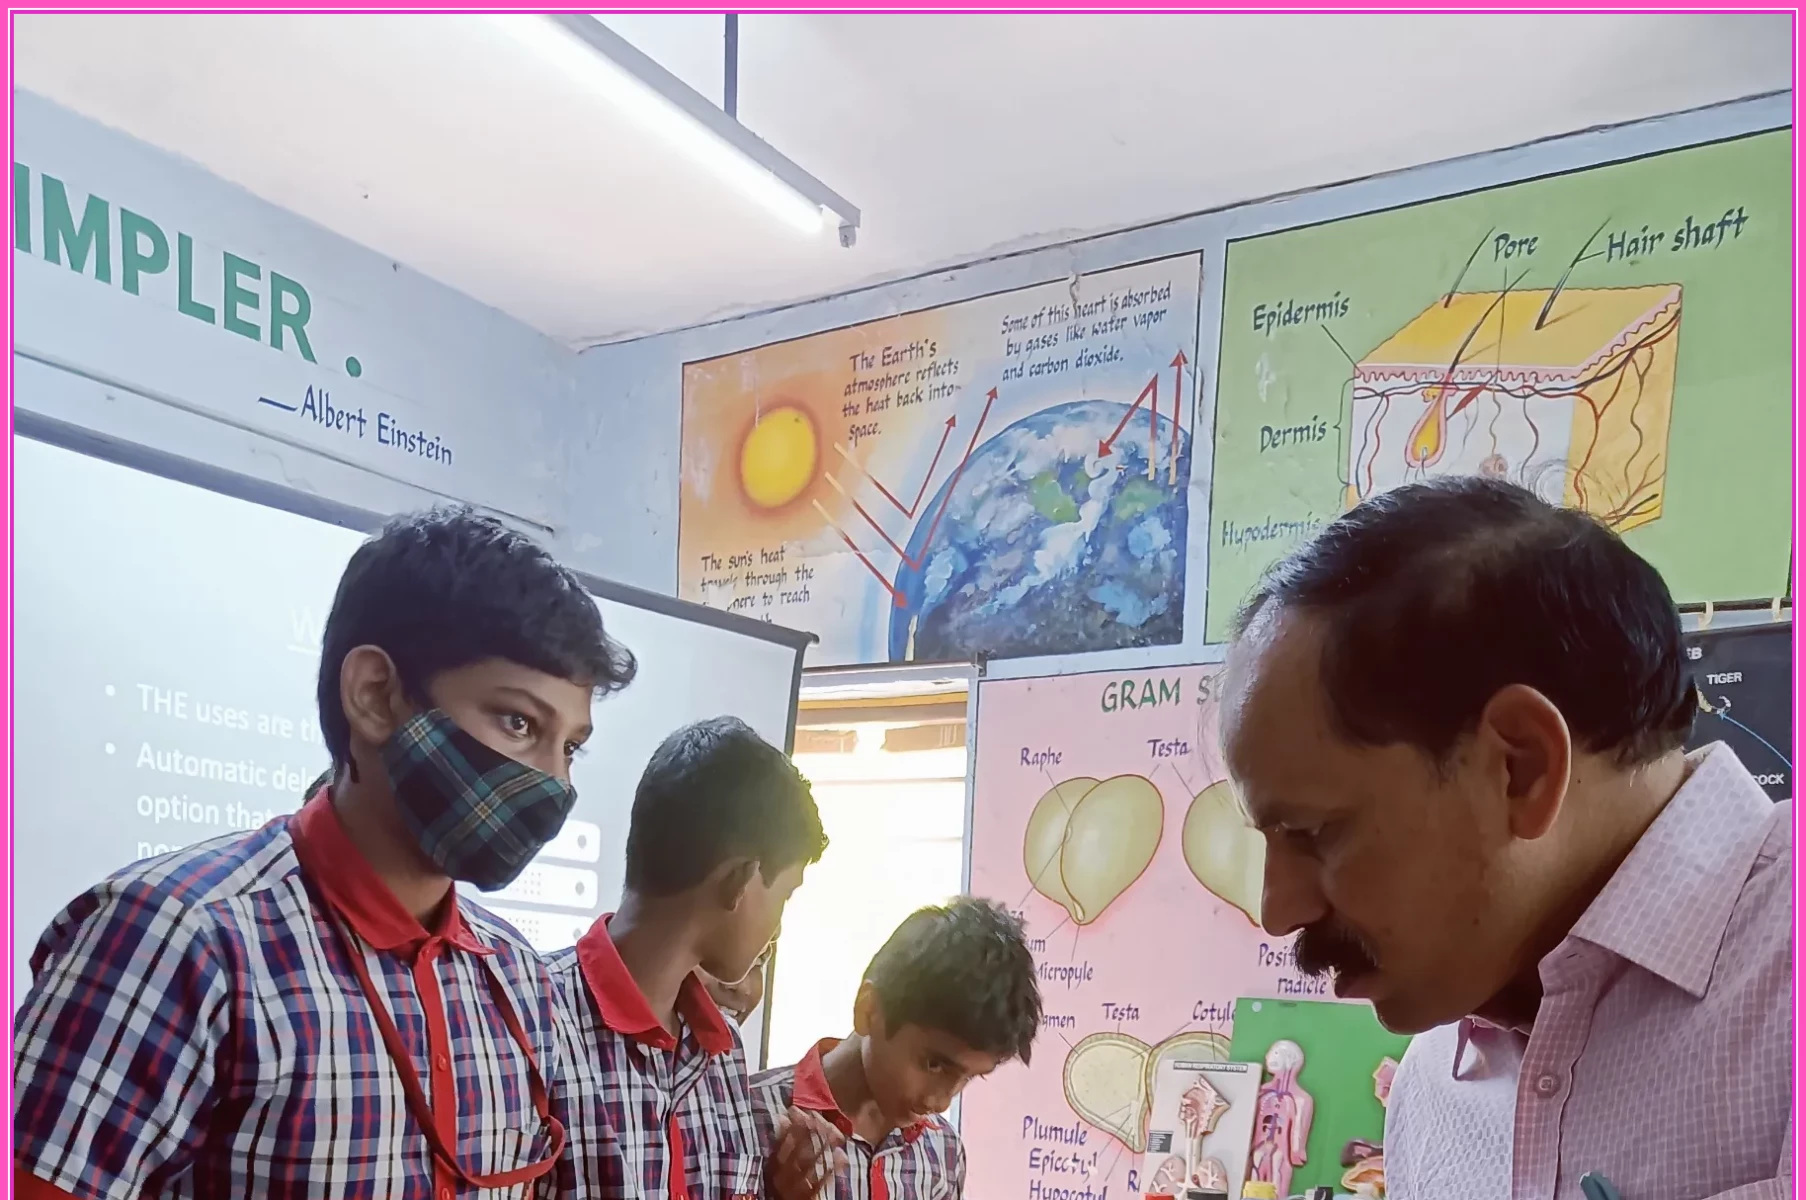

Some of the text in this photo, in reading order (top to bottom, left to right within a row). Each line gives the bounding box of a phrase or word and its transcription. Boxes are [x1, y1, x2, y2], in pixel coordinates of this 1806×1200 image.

[1493, 233, 1539, 263] Pore
[1606, 206, 1750, 263] Hair shaft
[1001, 314, 1028, 335] Some
[1031, 306, 1046, 328] of
[1048, 303, 1069, 324] this
[1110, 292, 1119, 311] is
[1121, 280, 1171, 309] absorbed
[1253, 291, 1350, 337] Epidermis
[1006, 308, 1167, 358] by gases like water vapor
[849, 338, 937, 372] The Earth's
[1002, 344, 1124, 382] and carbon dioxide.
[844, 358, 959, 397] atmosphere reflects
[842, 400, 860, 418] the
[865, 394, 891, 414] heat
[377, 412, 452, 466] Einstein
[848, 422, 882, 448] space.
[1260, 415, 1327, 453] Dermis
[701, 545, 786, 572] The sun's heat
[744, 566, 788, 591] through
[794, 563, 815, 582] the
[762, 592, 773, 607] to
[780, 584, 810, 605] reach
[1706, 671, 1743, 685] TIGER
[1101, 677, 1181, 713] GRAM
[136, 683, 189, 720] THE
[195, 701, 249, 731] uses
[257, 712, 293, 740] are
[1021, 746, 1062, 773] Raphe
[1147, 738, 1192, 758] Testa
[136, 741, 268, 788] Automatic
[136, 794, 220, 825] option
[1102, 1002, 1139, 1021] Testa
[1022, 1115, 1088, 1146] Plumule
